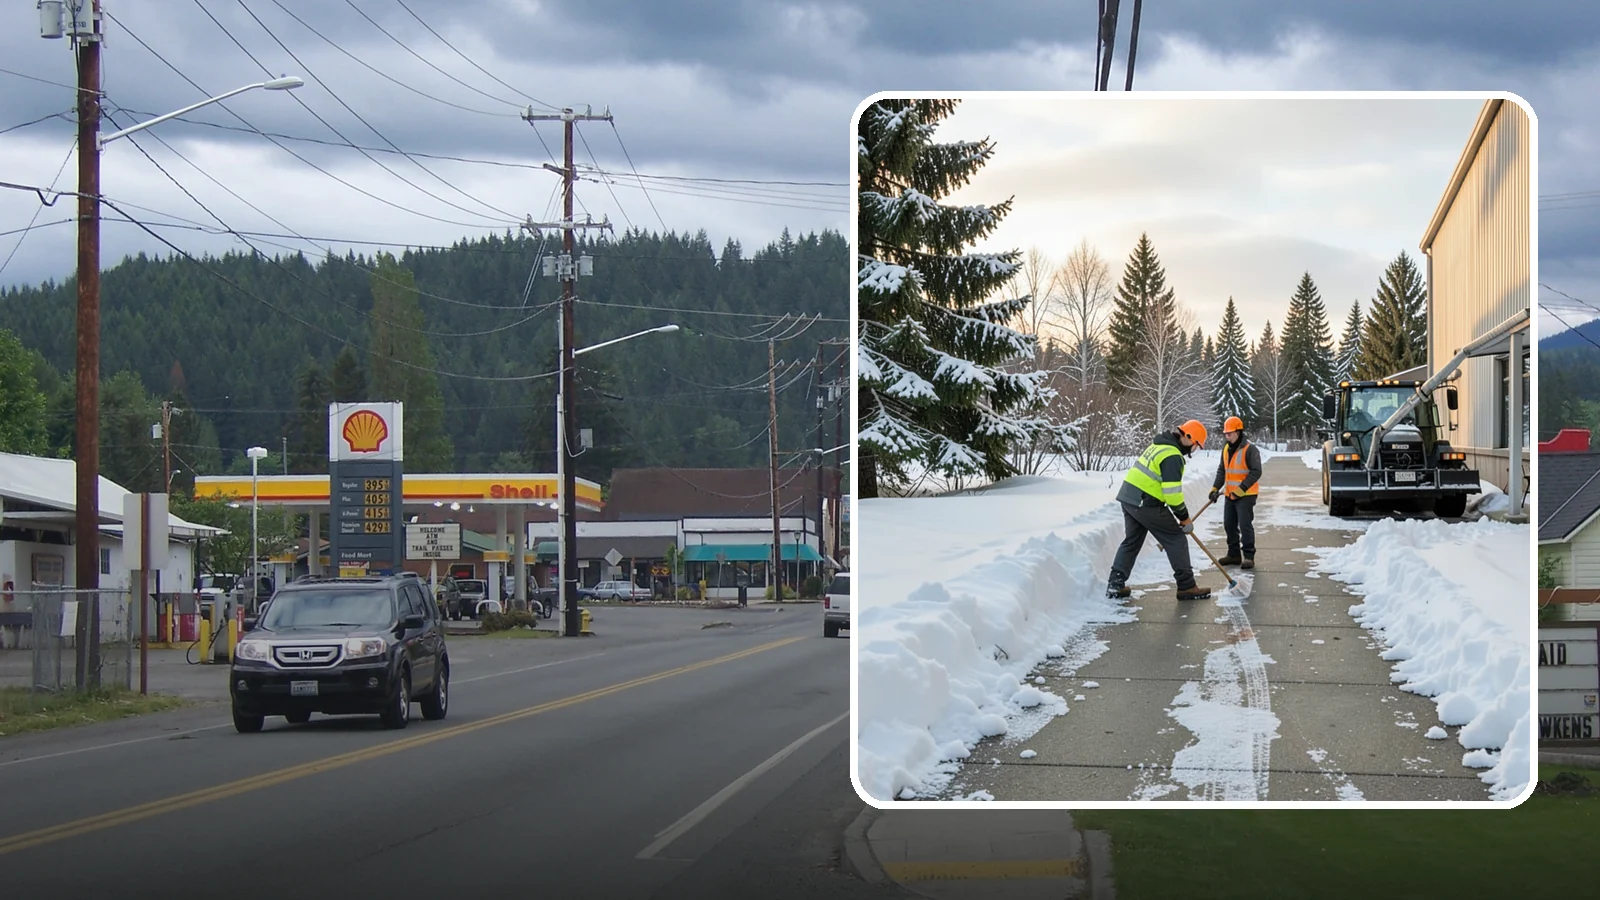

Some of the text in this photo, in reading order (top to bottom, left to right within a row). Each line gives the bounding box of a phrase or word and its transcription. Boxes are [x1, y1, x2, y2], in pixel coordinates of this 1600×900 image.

[366, 480, 384, 490] 395
[490, 484, 547, 499] Shell
[366, 494, 384, 504] 405
[366, 508, 384, 518] 415
[366, 522, 384, 533] 429
[1538, 643, 1566, 665] AID
[1538, 716, 1592, 739] WKENS
